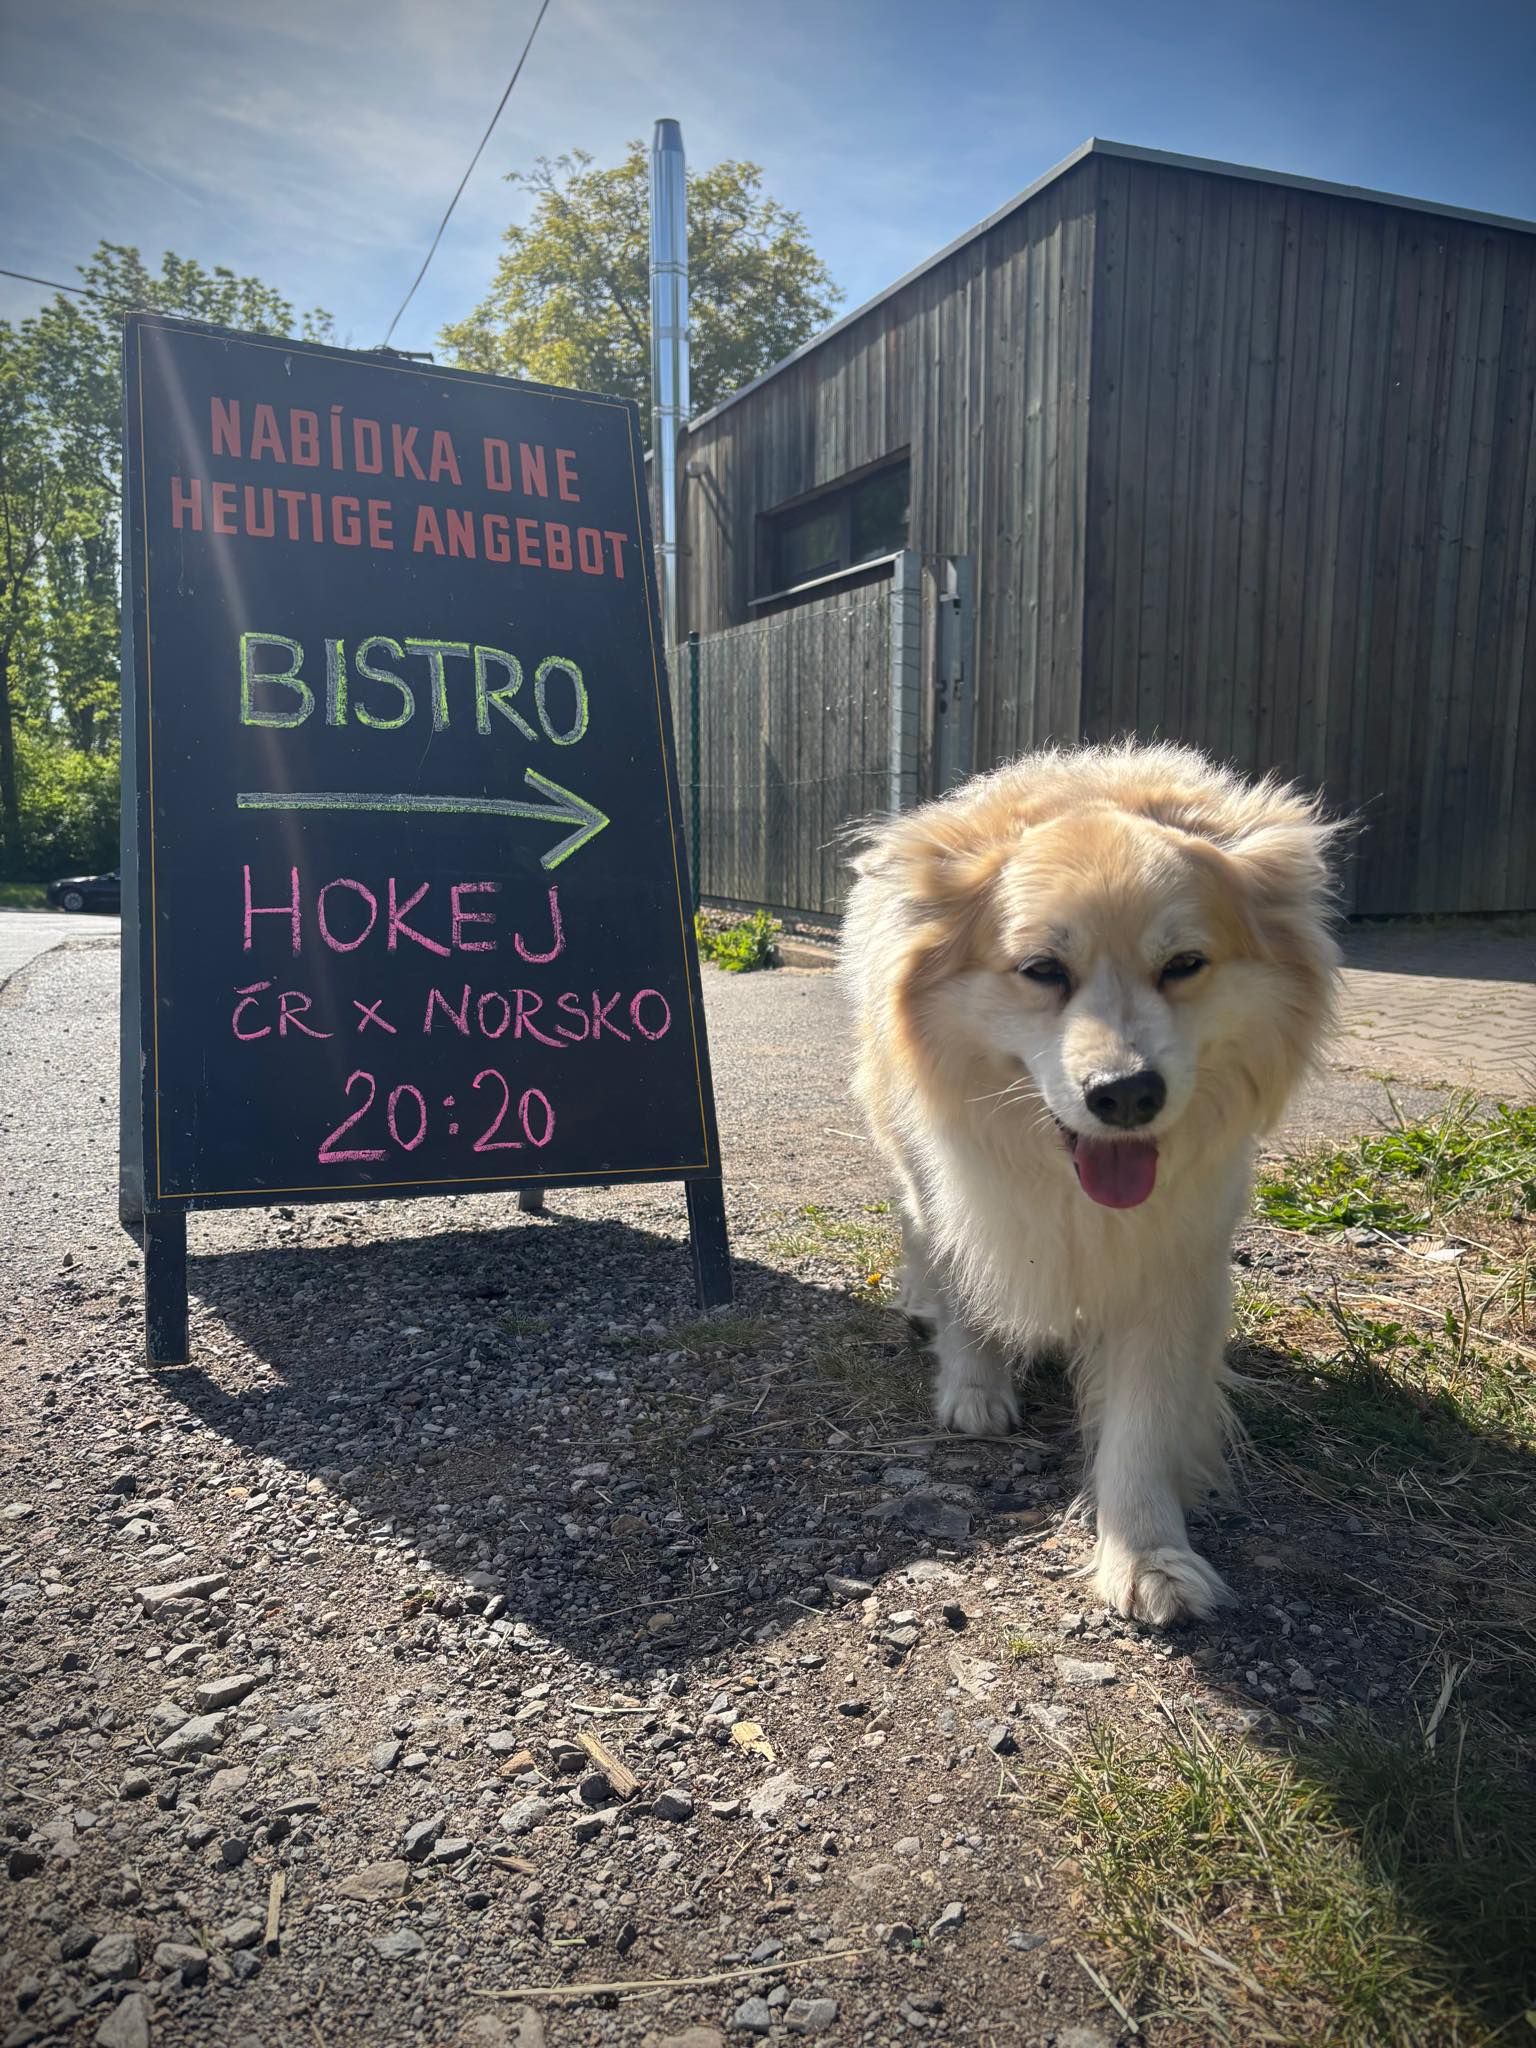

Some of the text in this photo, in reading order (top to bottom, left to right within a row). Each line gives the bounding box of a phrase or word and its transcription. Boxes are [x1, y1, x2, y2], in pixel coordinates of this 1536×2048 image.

[171, 476, 628, 579] HEUTIGE ANGEBOT
[238, 632, 589, 746] BISTRO
[243, 864, 566, 963] HOKEJ
[423, 984, 671, 1048] NORSKO
[318, 1069, 556, 1163] 20:20
